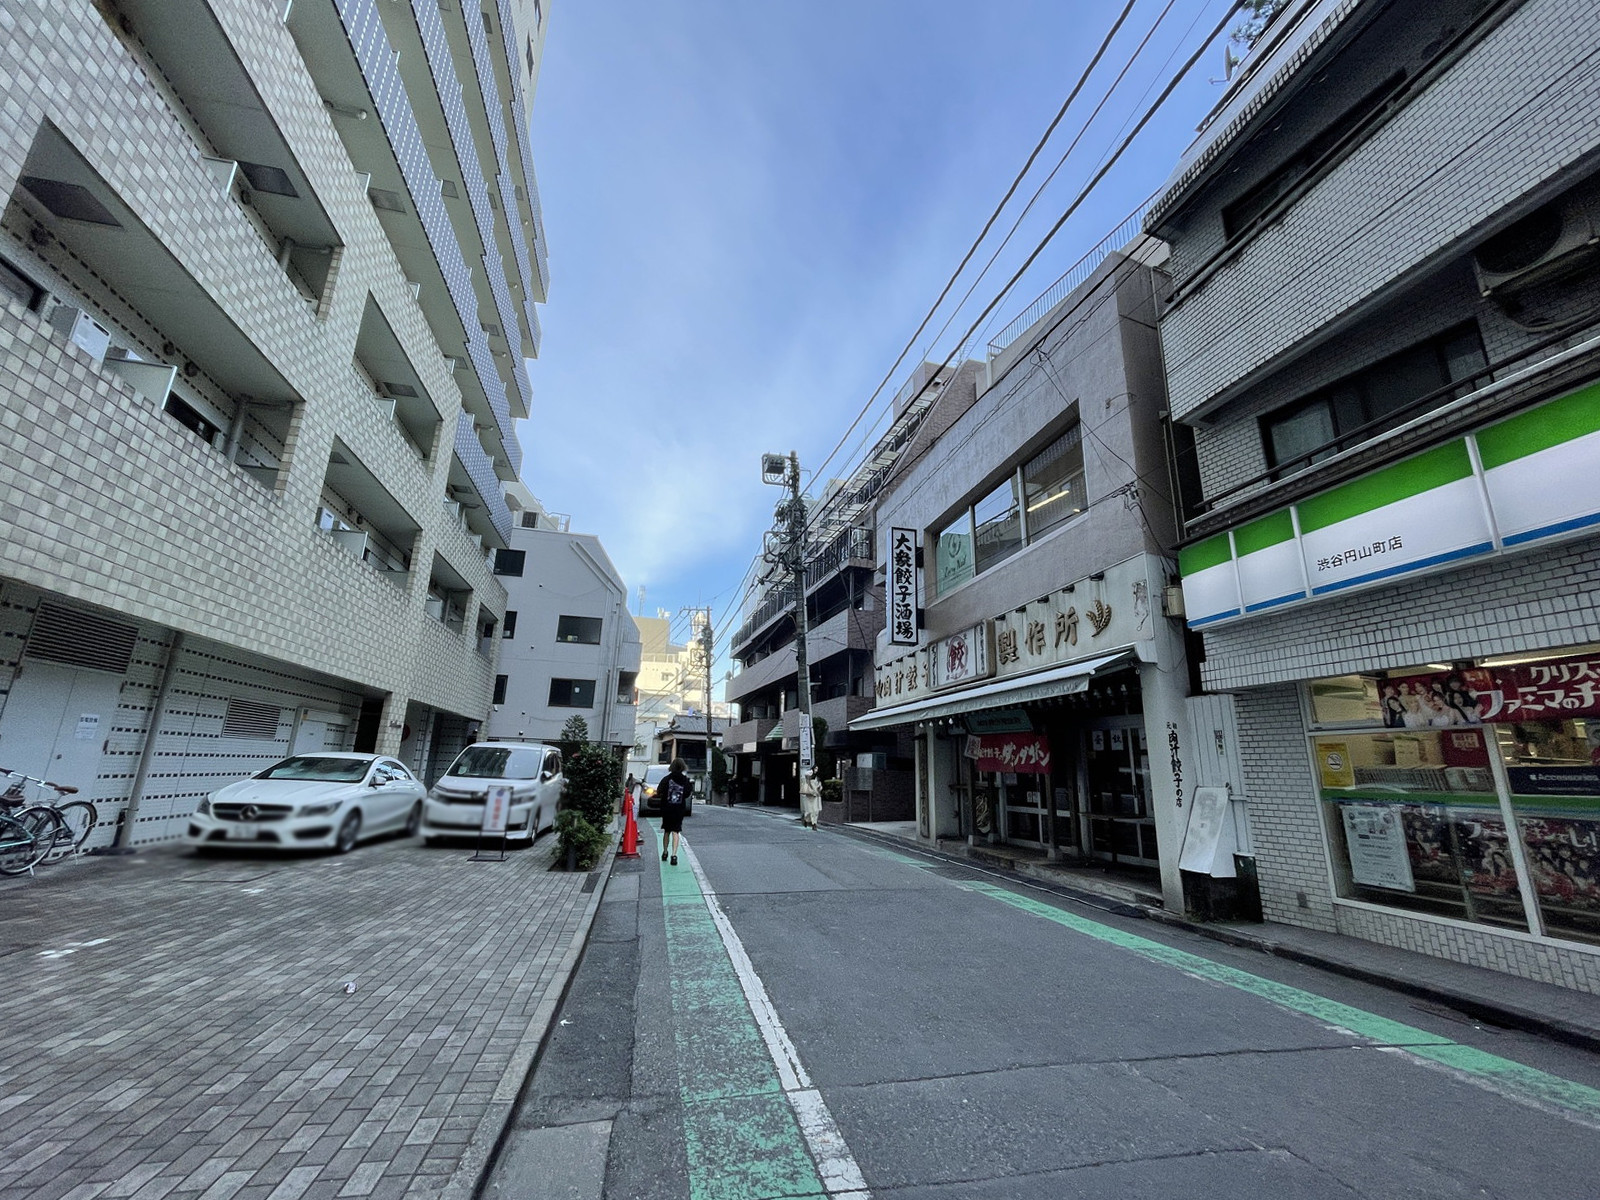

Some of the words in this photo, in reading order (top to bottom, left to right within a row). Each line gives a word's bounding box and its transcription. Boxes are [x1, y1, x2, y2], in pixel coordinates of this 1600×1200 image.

[1317, 535, 1403, 572] 渋谷円山町店
[895, 532, 913, 639] 大衆餃子酒場
[998, 606, 1080, 665] 製作所
